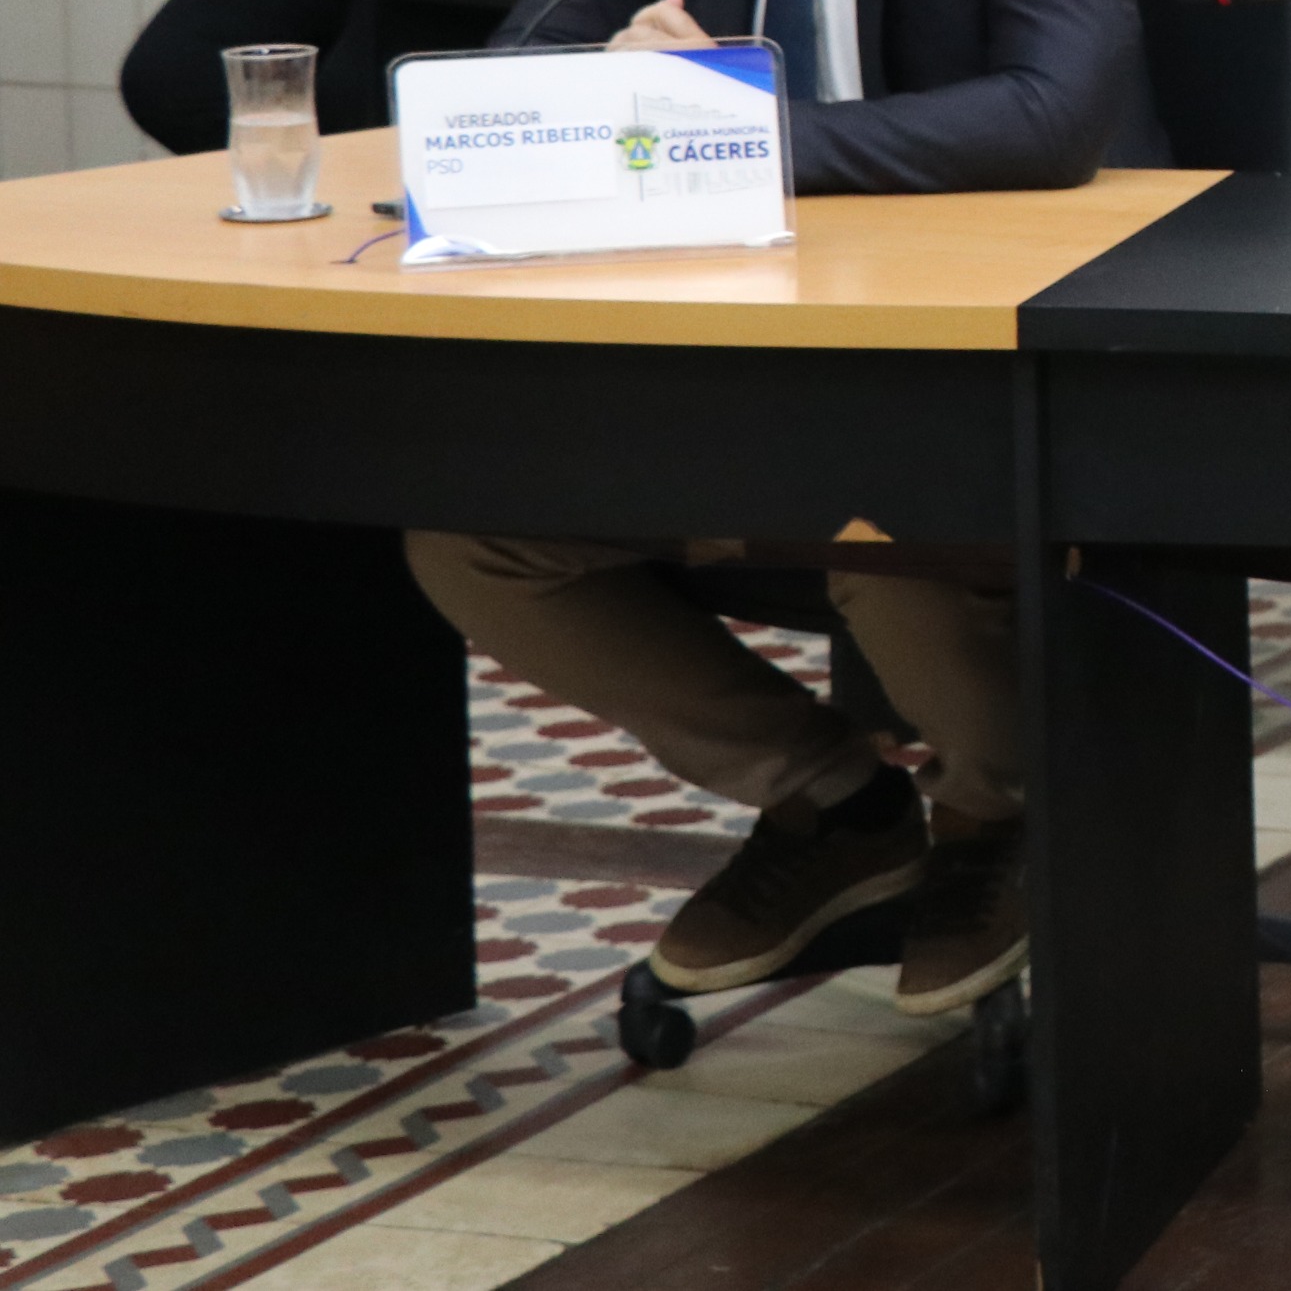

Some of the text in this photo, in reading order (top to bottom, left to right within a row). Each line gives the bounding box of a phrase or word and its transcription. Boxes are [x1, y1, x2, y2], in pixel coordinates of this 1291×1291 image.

[445, 111, 542, 129] VEREADOR
[426, 124, 613, 152] MARCOS RIBEIRO
[663, 124, 771, 140] CÂMARA MUNICIPAL
[668, 138, 769, 162] CÁCERES
[426, 158, 464, 174] PSD
